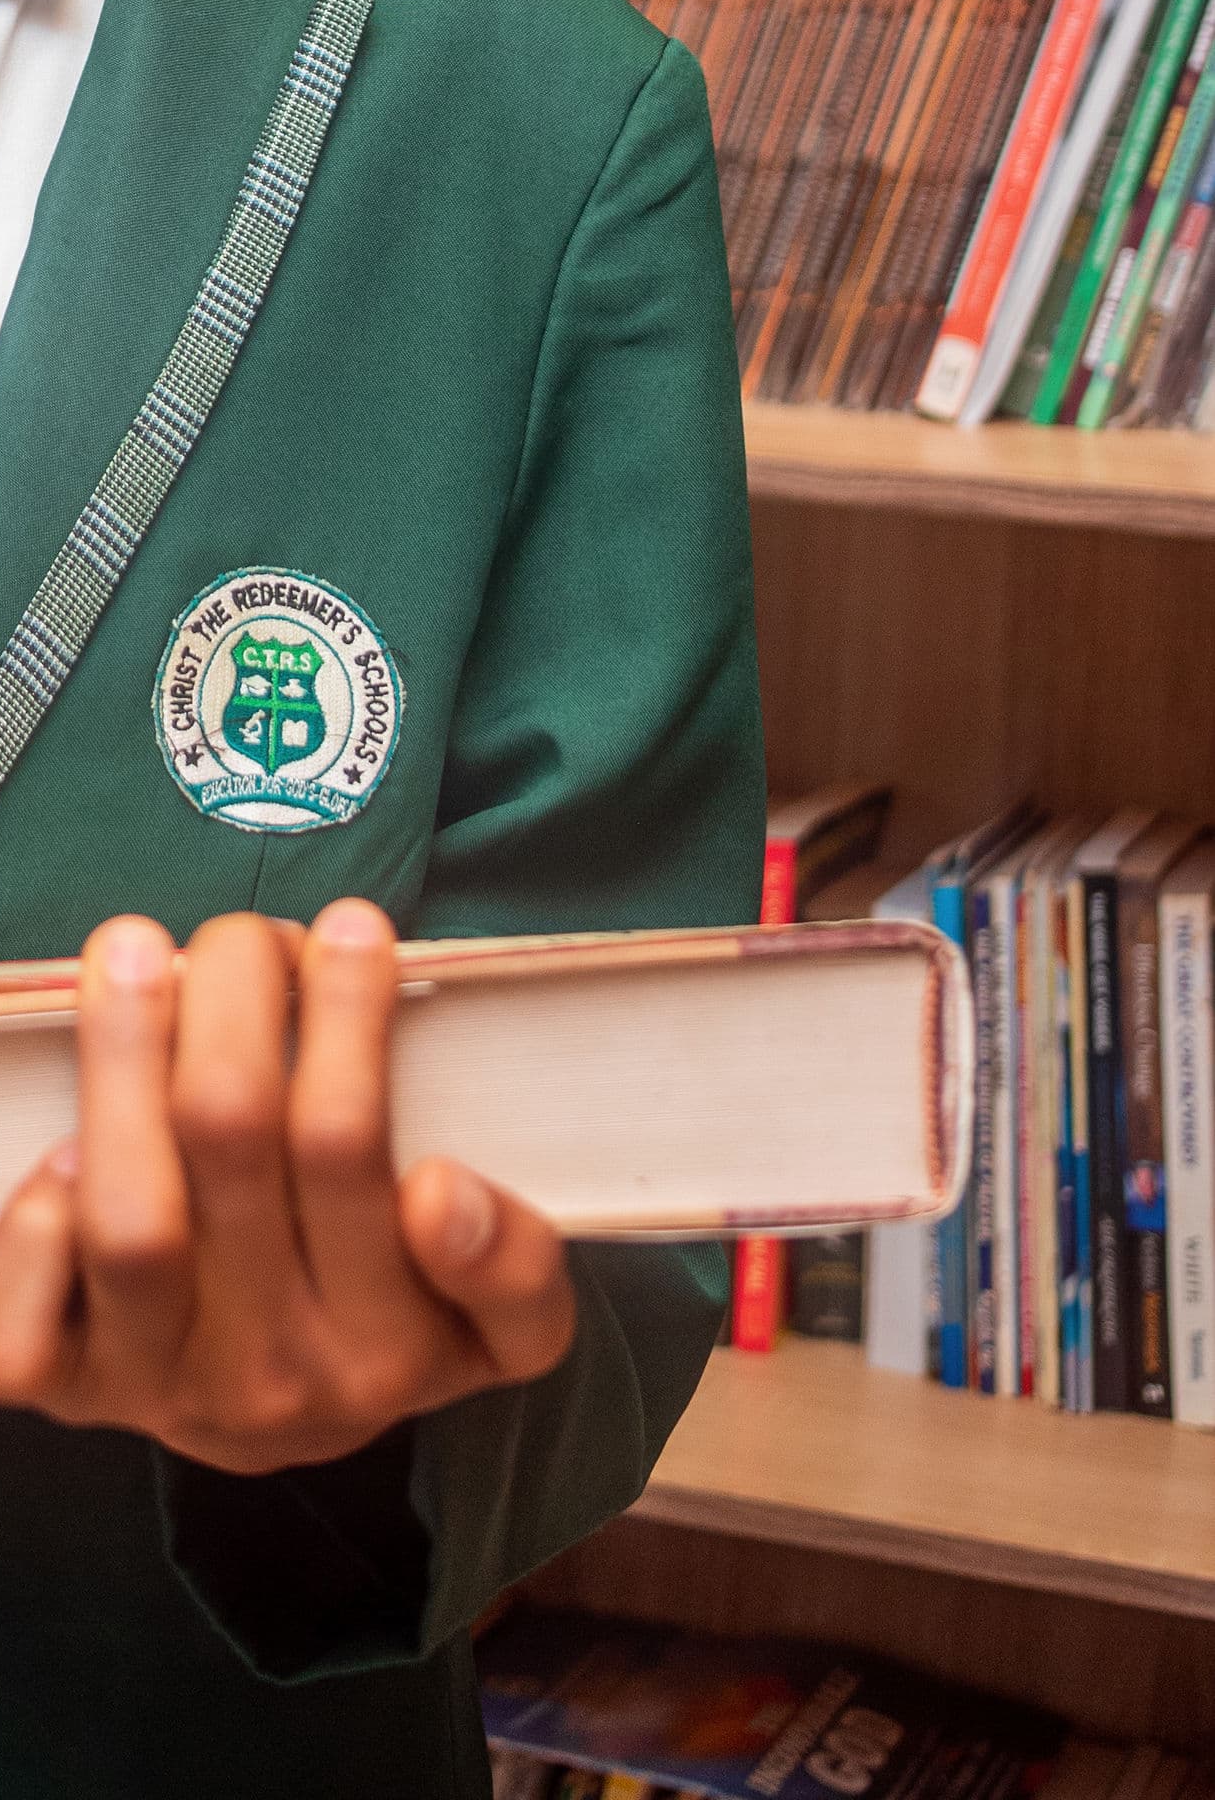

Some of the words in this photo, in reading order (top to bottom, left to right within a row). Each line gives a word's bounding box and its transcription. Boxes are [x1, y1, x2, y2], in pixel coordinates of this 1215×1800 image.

[170, 646, 202, 731] CHRIST
[192, 600, 232, 642] THE
[231, 582, 363, 645] REDEEMER'S
[354, 649, 389, 764] SCHOOLS
